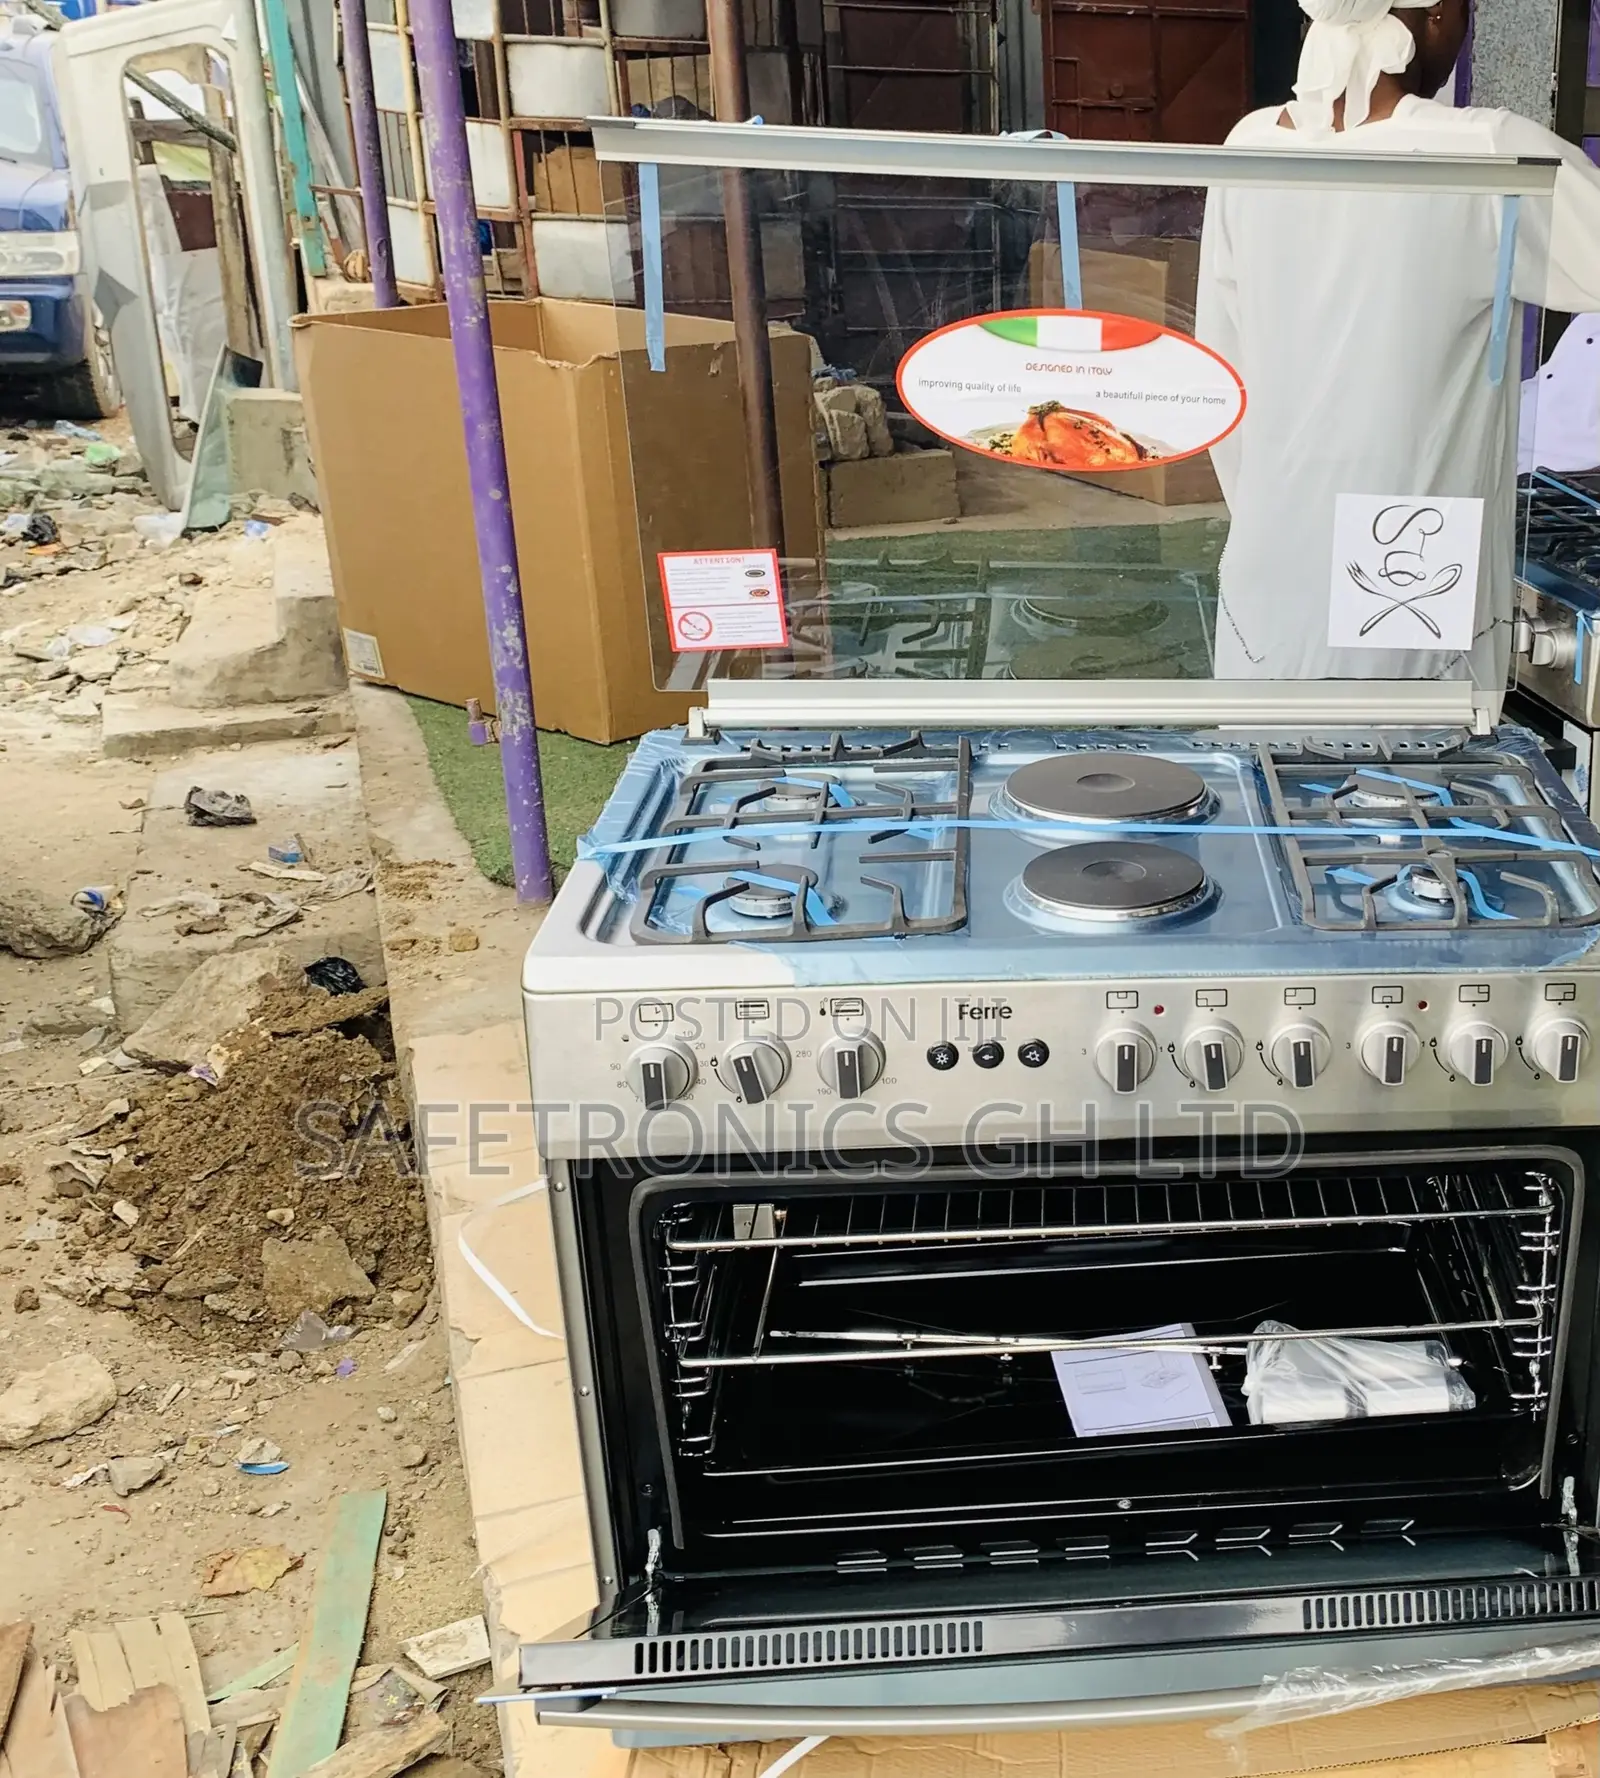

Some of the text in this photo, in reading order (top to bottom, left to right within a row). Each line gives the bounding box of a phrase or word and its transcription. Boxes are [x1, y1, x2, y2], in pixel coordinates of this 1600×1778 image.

[1025, 362, 1073, 373] DESIGNED
[965, 383, 994, 393] quality
[997, 384, 1006, 392] of
[1008, 383, 1022, 393] life
[1095, 389, 1227, 405] a beautifull piece of your home
[958, 1003, 1013, 1020] Ferre
[695, 1042, 706, 1050] 20
[795, 1050, 812, 1058] 280
[1081, 1047, 1087, 1056] 3
[609, 1063, 622, 1071] 90
[699, 1060, 709, 1068] 30
[881, 1077, 898, 1085] 100
